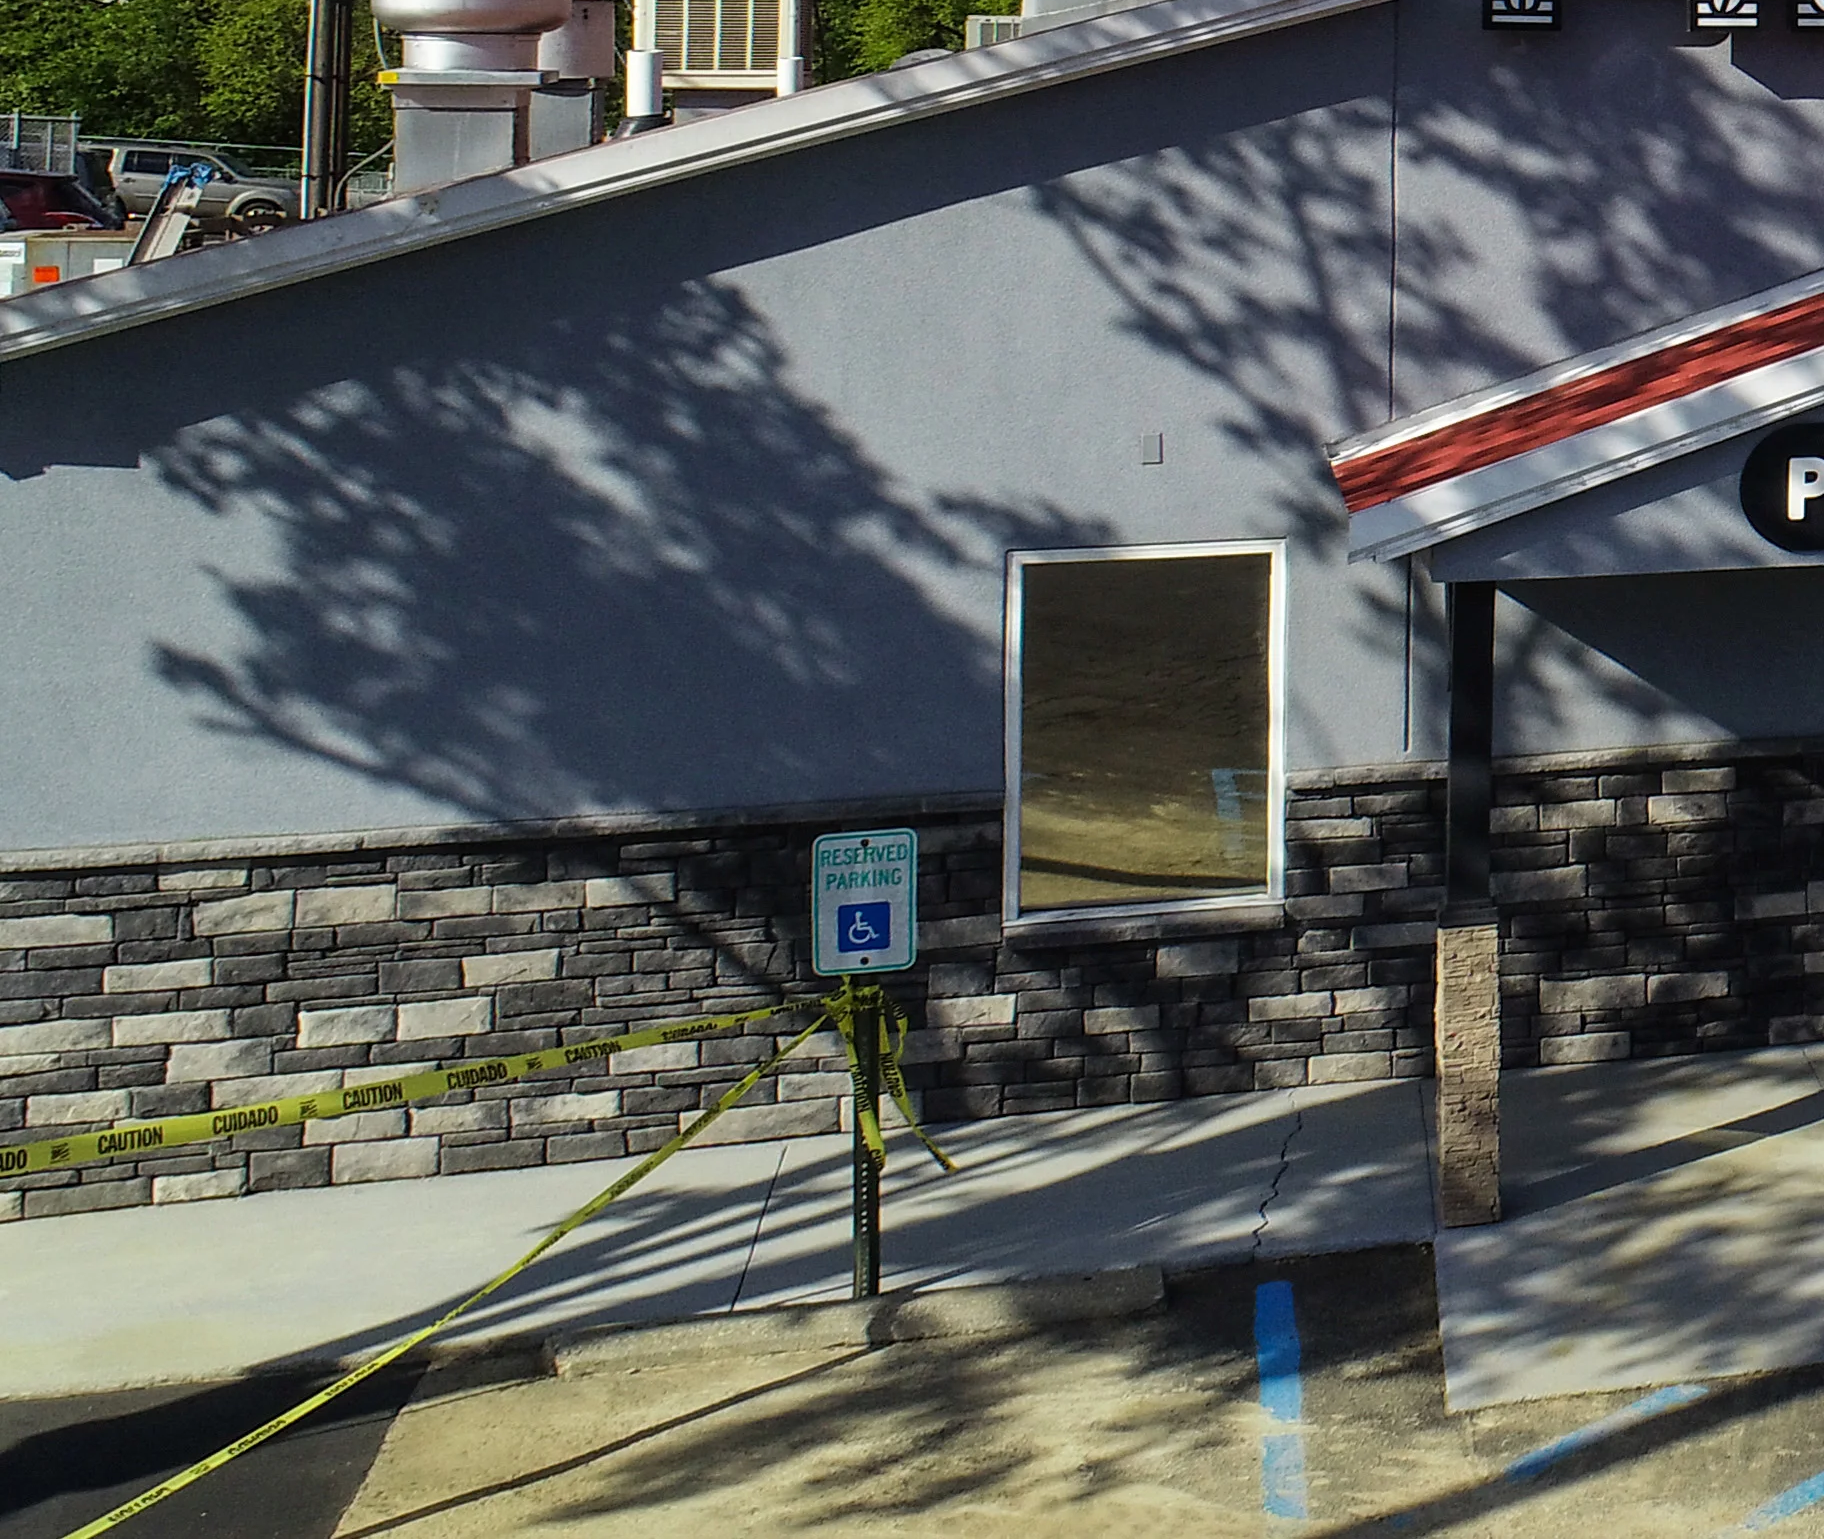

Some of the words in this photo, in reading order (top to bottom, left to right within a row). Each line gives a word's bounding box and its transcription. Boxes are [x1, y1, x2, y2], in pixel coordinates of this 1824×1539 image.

[820, 843, 909, 867] RESERVED
[825, 868, 903, 891] PARKING
[97, 1125, 163, 1154] CAUTION
[212, 1105, 279, 1134] CUIDADO
[342, 1082, 403, 1110] CAUTION
[447, 1062, 508, 1090] CUIDADO
[564, 1040, 622, 1064] CAUTION
